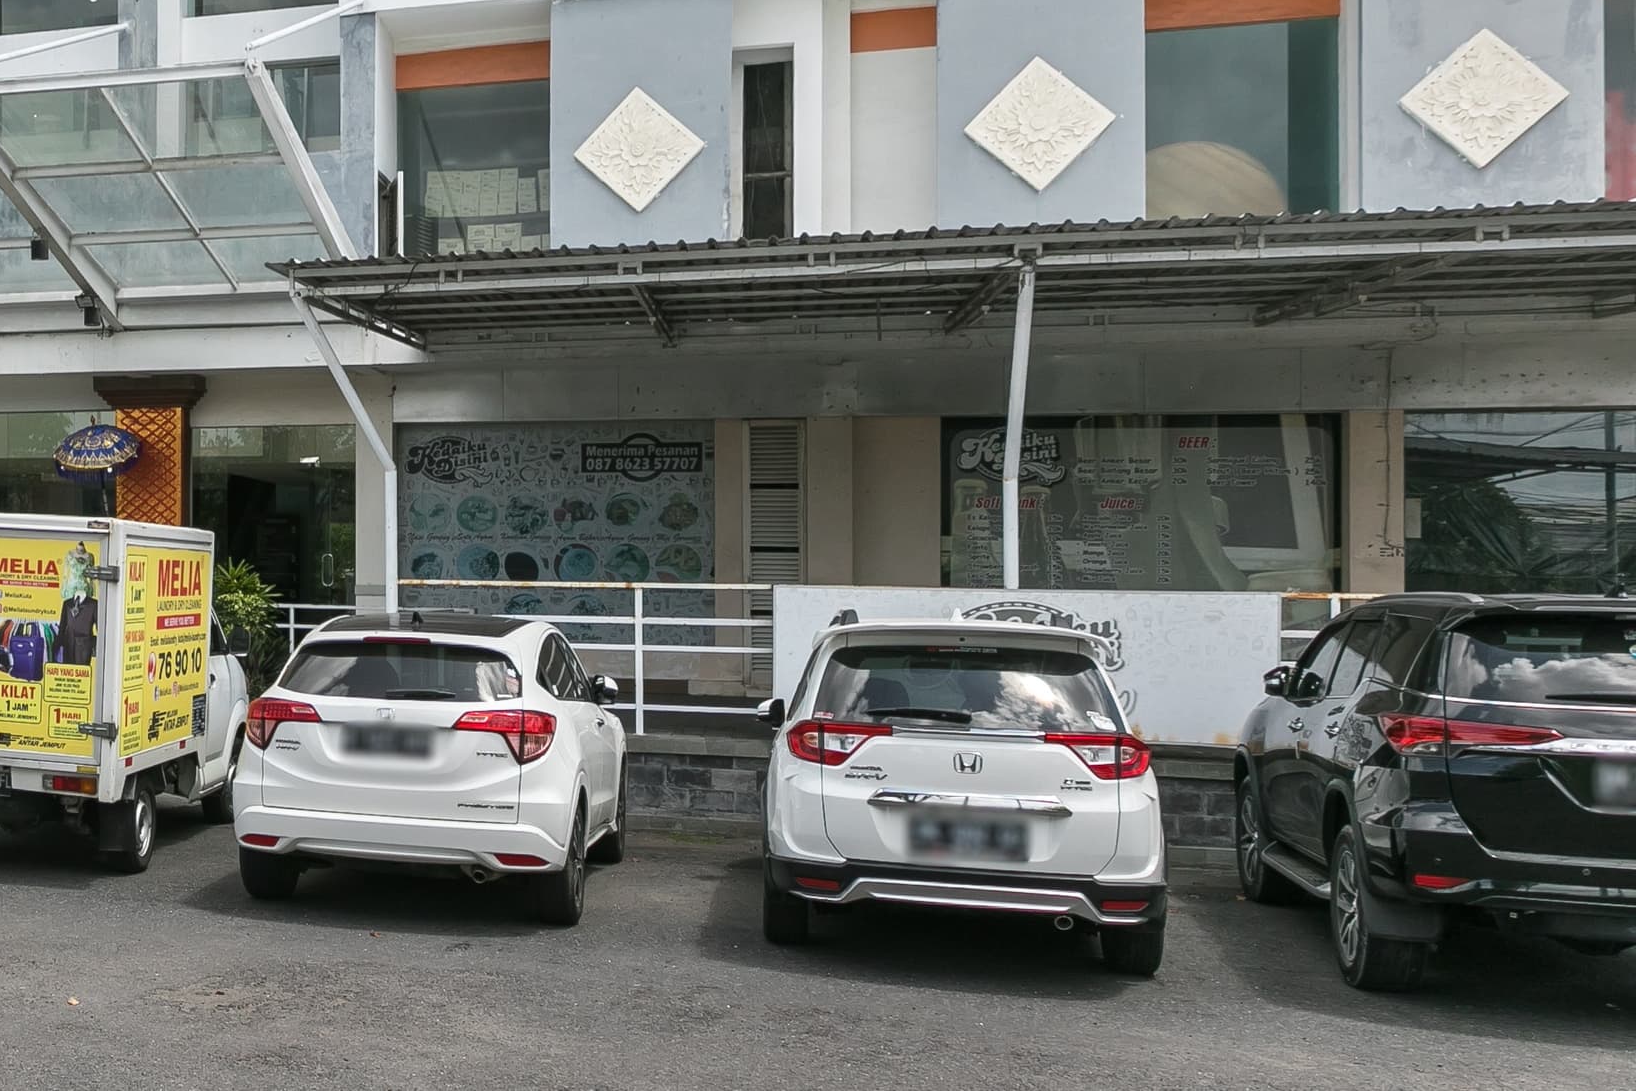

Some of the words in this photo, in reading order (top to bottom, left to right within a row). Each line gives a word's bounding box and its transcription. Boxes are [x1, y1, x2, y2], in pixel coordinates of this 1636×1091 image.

[1178, 437, 1210, 449] BEER
[405, 440, 487, 475] Kedaiku
[586, 446, 645, 457] Menerima
[648, 445, 698, 457] Pesanan
[433, 450, 489, 476] Disini
[586, 458, 613, 470] 087
[615, 458, 650, 470] 8623
[654, 457, 698, 470] 57707
[1100, 495, 1135, 509] Juice
[129, 561, 145, 582] KILAT
[157, 559, 202, 597] MELIA
[158, 651, 172, 680] 76
[175, 649, 189, 677] 90
[191, 647, 202, 673] 10
[47, 667, 60, 675] HARI
[60, 669, 74, 677] YANG
[75, 669, 90, 677] SAMA
[1, 684, 36, 699] KILAT
[5, 699, 11, 711] 1
[124, 695, 129, 727] 1
[53, 708, 61, 724] 1
[61, 712, 81, 720] HARI
[39, 741, 66, 749] JEMPUT
